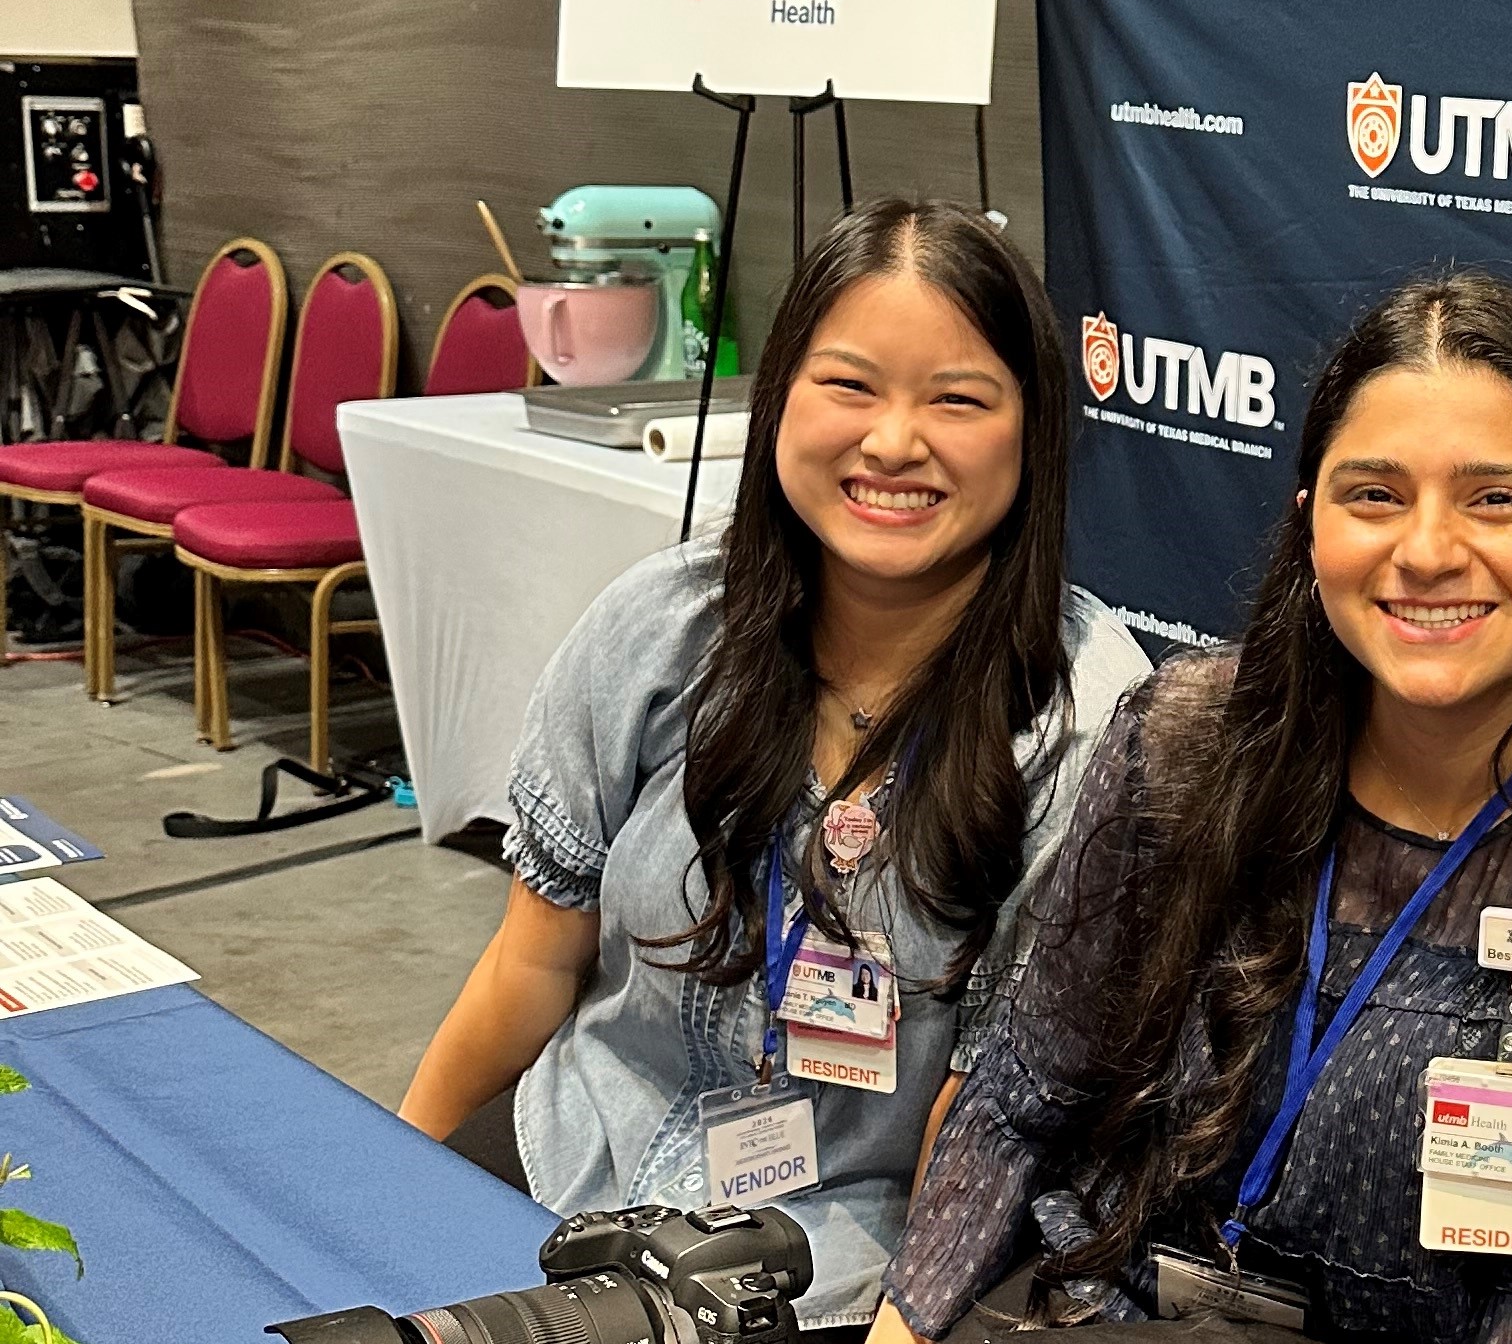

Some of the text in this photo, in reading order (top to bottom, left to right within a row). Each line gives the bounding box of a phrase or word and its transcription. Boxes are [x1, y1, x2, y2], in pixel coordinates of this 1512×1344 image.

[1110, 101, 1244, 136] utmbhealth.com
[1436, 193, 1453, 208] OF
[1454, 195, 1493, 213] TEXAS
[1121, 332, 1276, 429] UTMB
[1157, 424, 1189, 442] TEXAS
[803, 966, 836, 983] UTMB
[800, 1058, 880, 1086] RESIDENT
[1437, 1113, 1507, 1131] utmb Health
[1474, 1141, 1504, 1154] Booth
[720, 1155, 806, 1199] VENDOR
